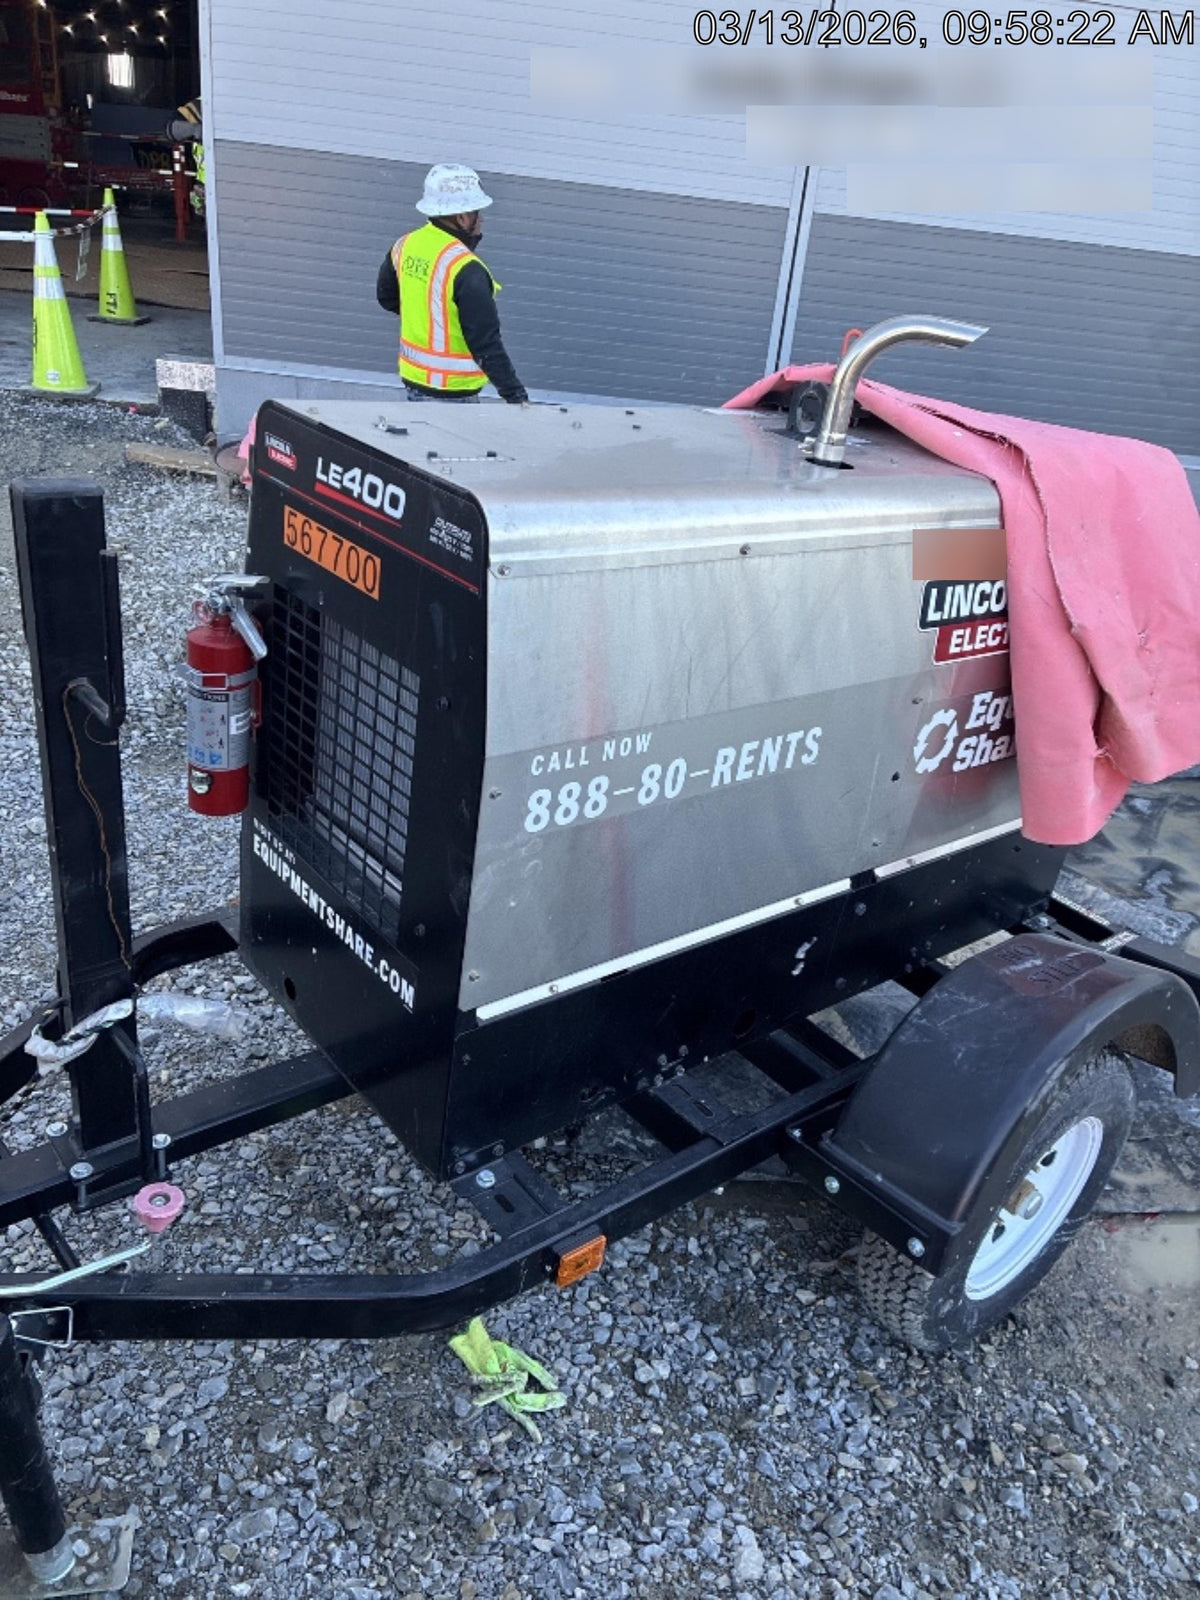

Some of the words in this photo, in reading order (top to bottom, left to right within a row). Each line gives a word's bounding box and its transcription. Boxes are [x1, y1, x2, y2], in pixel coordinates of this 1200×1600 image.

[315, 456, 406, 520] LE400
[286, 510, 378, 594] 567700
[926, 580, 1007, 622] LINCO
[949, 622, 1008, 654] ELECT
[965, 690, 1013, 732] Equ
[524, 726, 823, 834] 888-80-RENTS
[531, 755, 590, 776] CALL
[602, 732, 653, 762] NOW
[253, 833, 415, 1009] EQUIPMENTSHARE.COM
